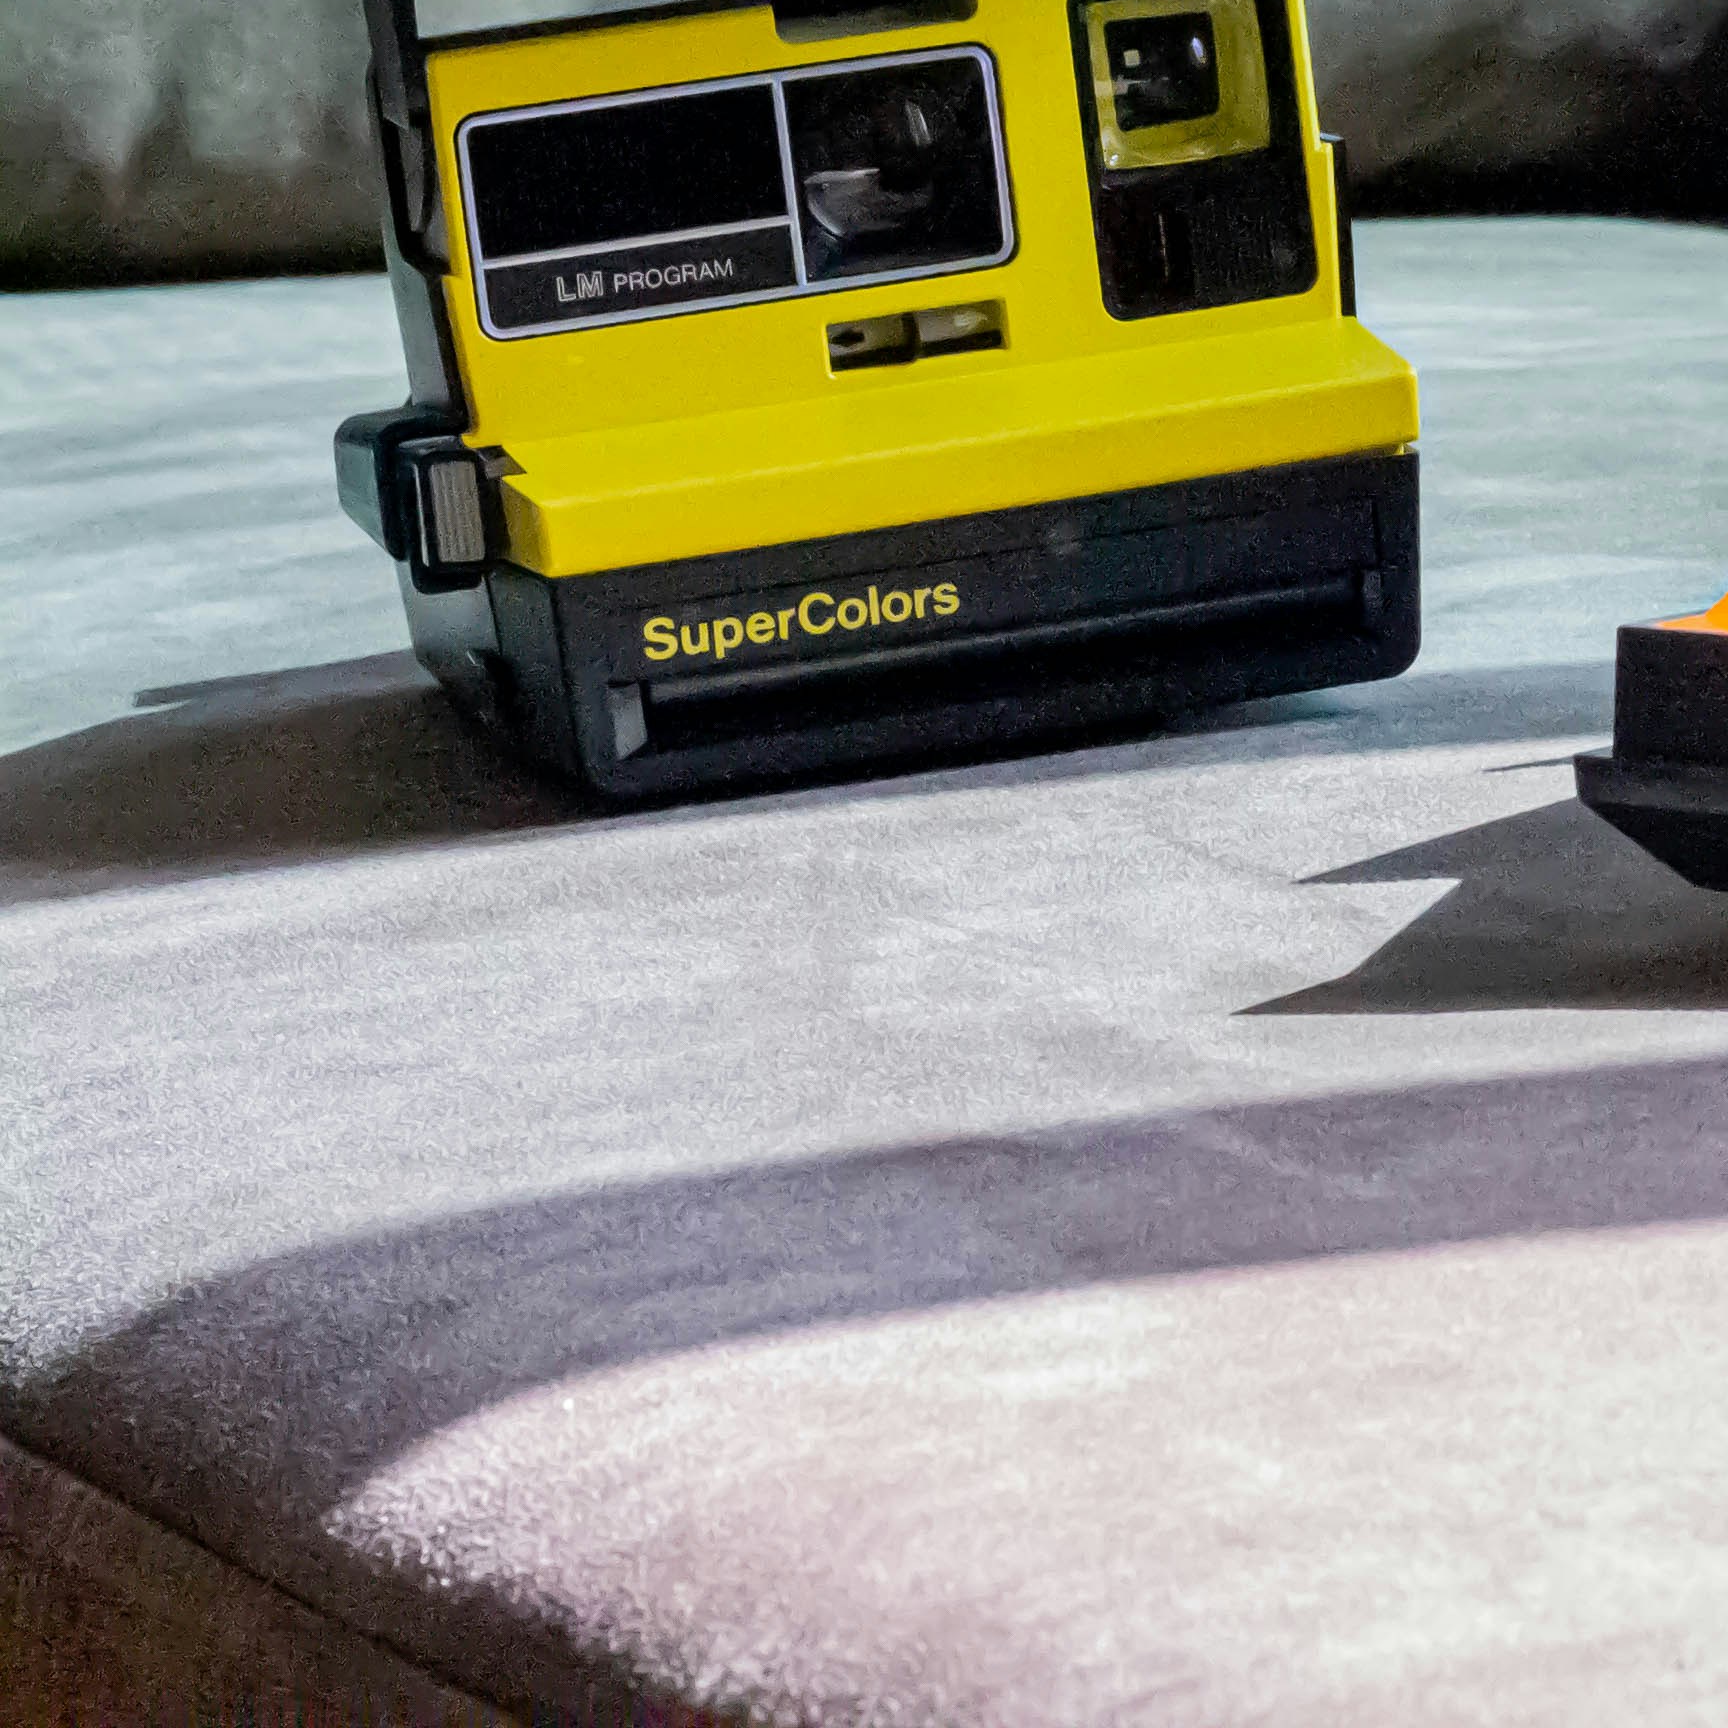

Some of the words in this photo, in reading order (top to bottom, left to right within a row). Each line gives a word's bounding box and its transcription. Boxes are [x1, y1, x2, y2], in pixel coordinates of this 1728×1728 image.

[556, 271, 603, 302] LM
[613, 258, 734, 293] PROGRAM
[643, 582, 961, 660] SuperColors
